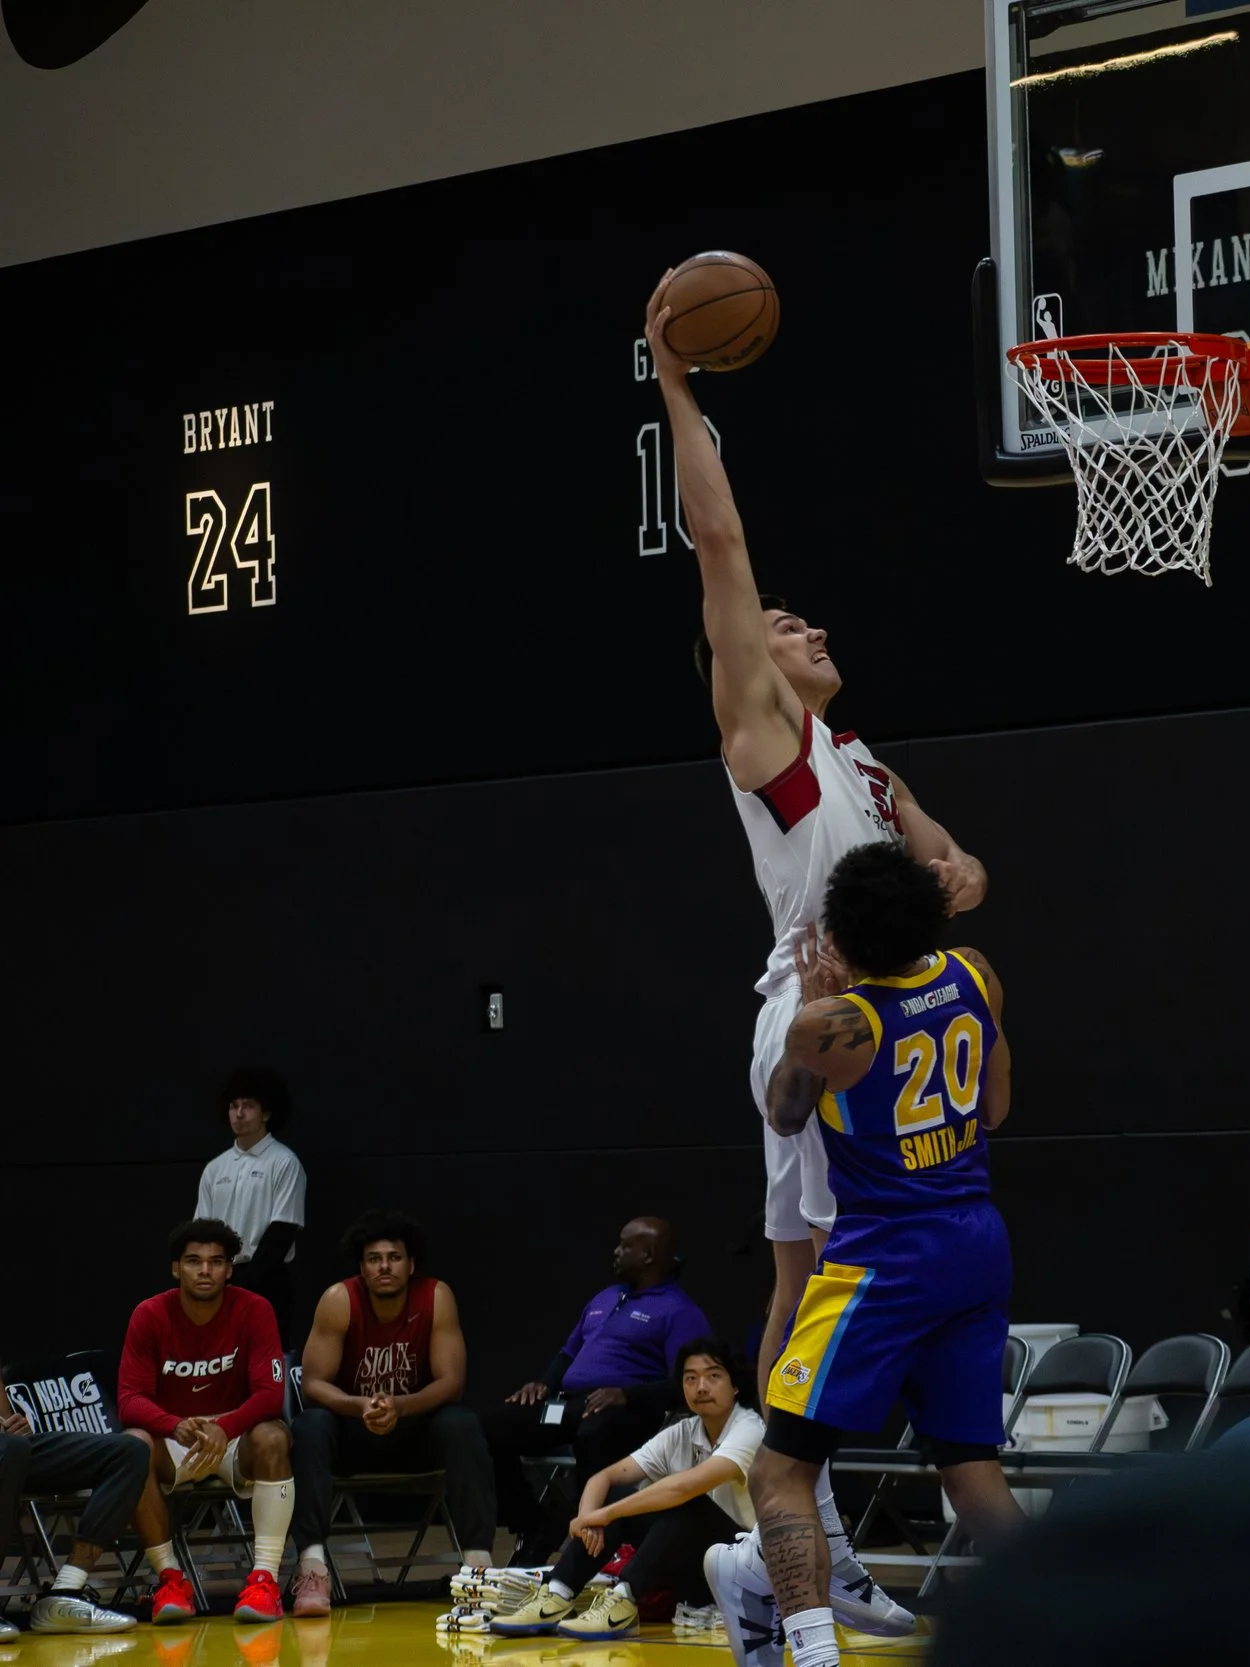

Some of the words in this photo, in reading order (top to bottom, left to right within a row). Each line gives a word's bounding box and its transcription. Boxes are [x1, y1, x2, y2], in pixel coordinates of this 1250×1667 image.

[182, 400, 275, 455] BRYANT
[186, 481, 277, 615] 24
[893, 1012, 983, 1137] 20
[900, 1125, 957, 1171] SMITH
[162, 1346, 239, 1378] FORCE
[33, 1376, 77, 1414] NBA
[70, 1371, 101, 1404] G
[44, 1402, 113, 1434] LEAGUE
